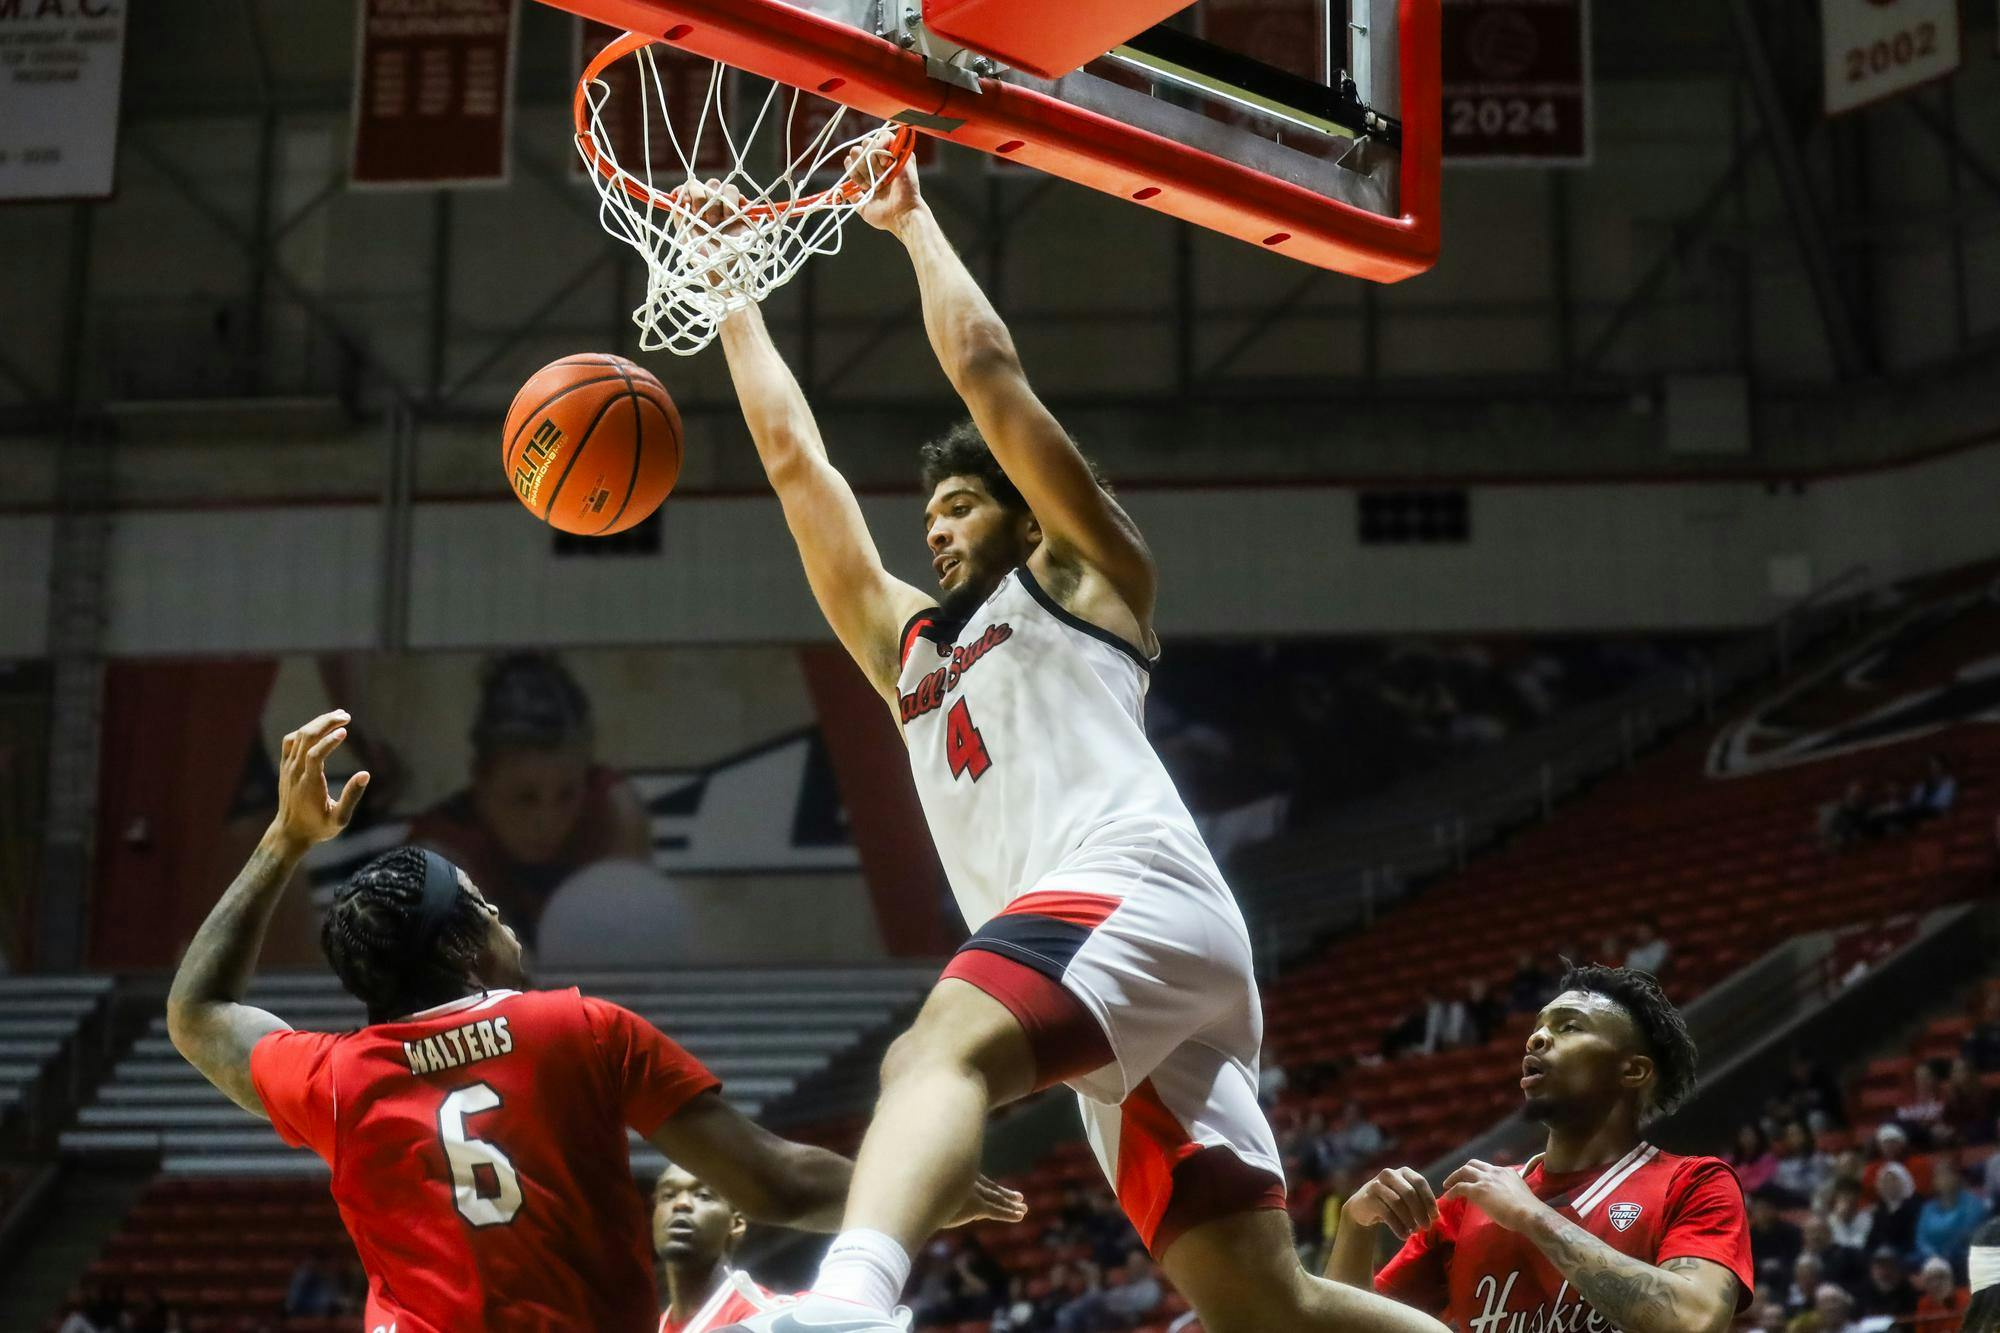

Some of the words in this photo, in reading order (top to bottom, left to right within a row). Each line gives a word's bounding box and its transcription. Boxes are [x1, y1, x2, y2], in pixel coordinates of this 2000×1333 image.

[1846, 21, 1937, 82] 2002
[1450, 98, 1558, 137] 2024
[896, 666, 947, 724] all
[946, 694, 993, 785] 4
[402, 1015, 514, 1076] WALTERS
[438, 1080, 524, 1227] 6
[1610, 1210, 1638, 1220] MAC
[1469, 1270, 1625, 1333] Huskie
